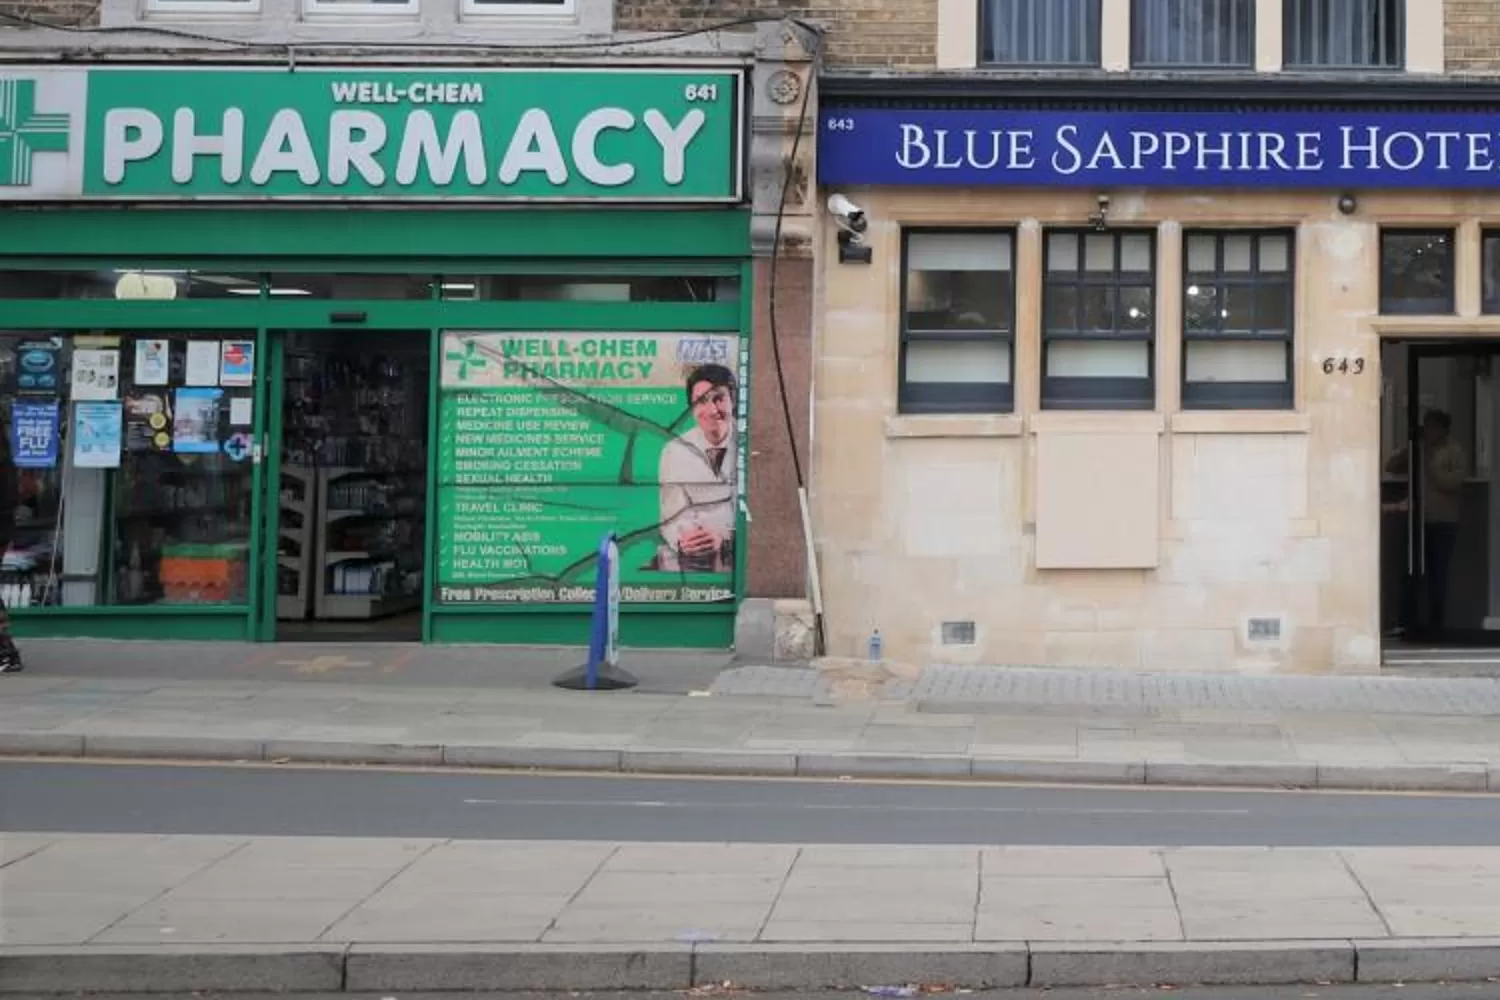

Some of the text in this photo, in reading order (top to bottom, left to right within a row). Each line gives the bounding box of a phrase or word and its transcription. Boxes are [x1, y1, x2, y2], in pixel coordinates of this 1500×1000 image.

[332, 83, 483, 103] WELL-CHEM
[685, 84, 717, 100] 641
[828, 118, 854, 131] 643
[102, 107, 706, 186] PHARMACY
[895, 123, 1036, 170] BLUE
[1051, 124, 1324, 175] SAPPHIRE
[501, 338, 657, 358] WELL-CHEM
[680, 340, 727, 360] NHS
[503, 361, 653, 380] PHARMACY
[1322, 357, 1365, 375] 643
[455, 502, 500, 514] TRAVEL
[453, 545, 476, 556] FLU
[441, 586, 472, 602] Free
[474, 586, 556, 602] Prescription
